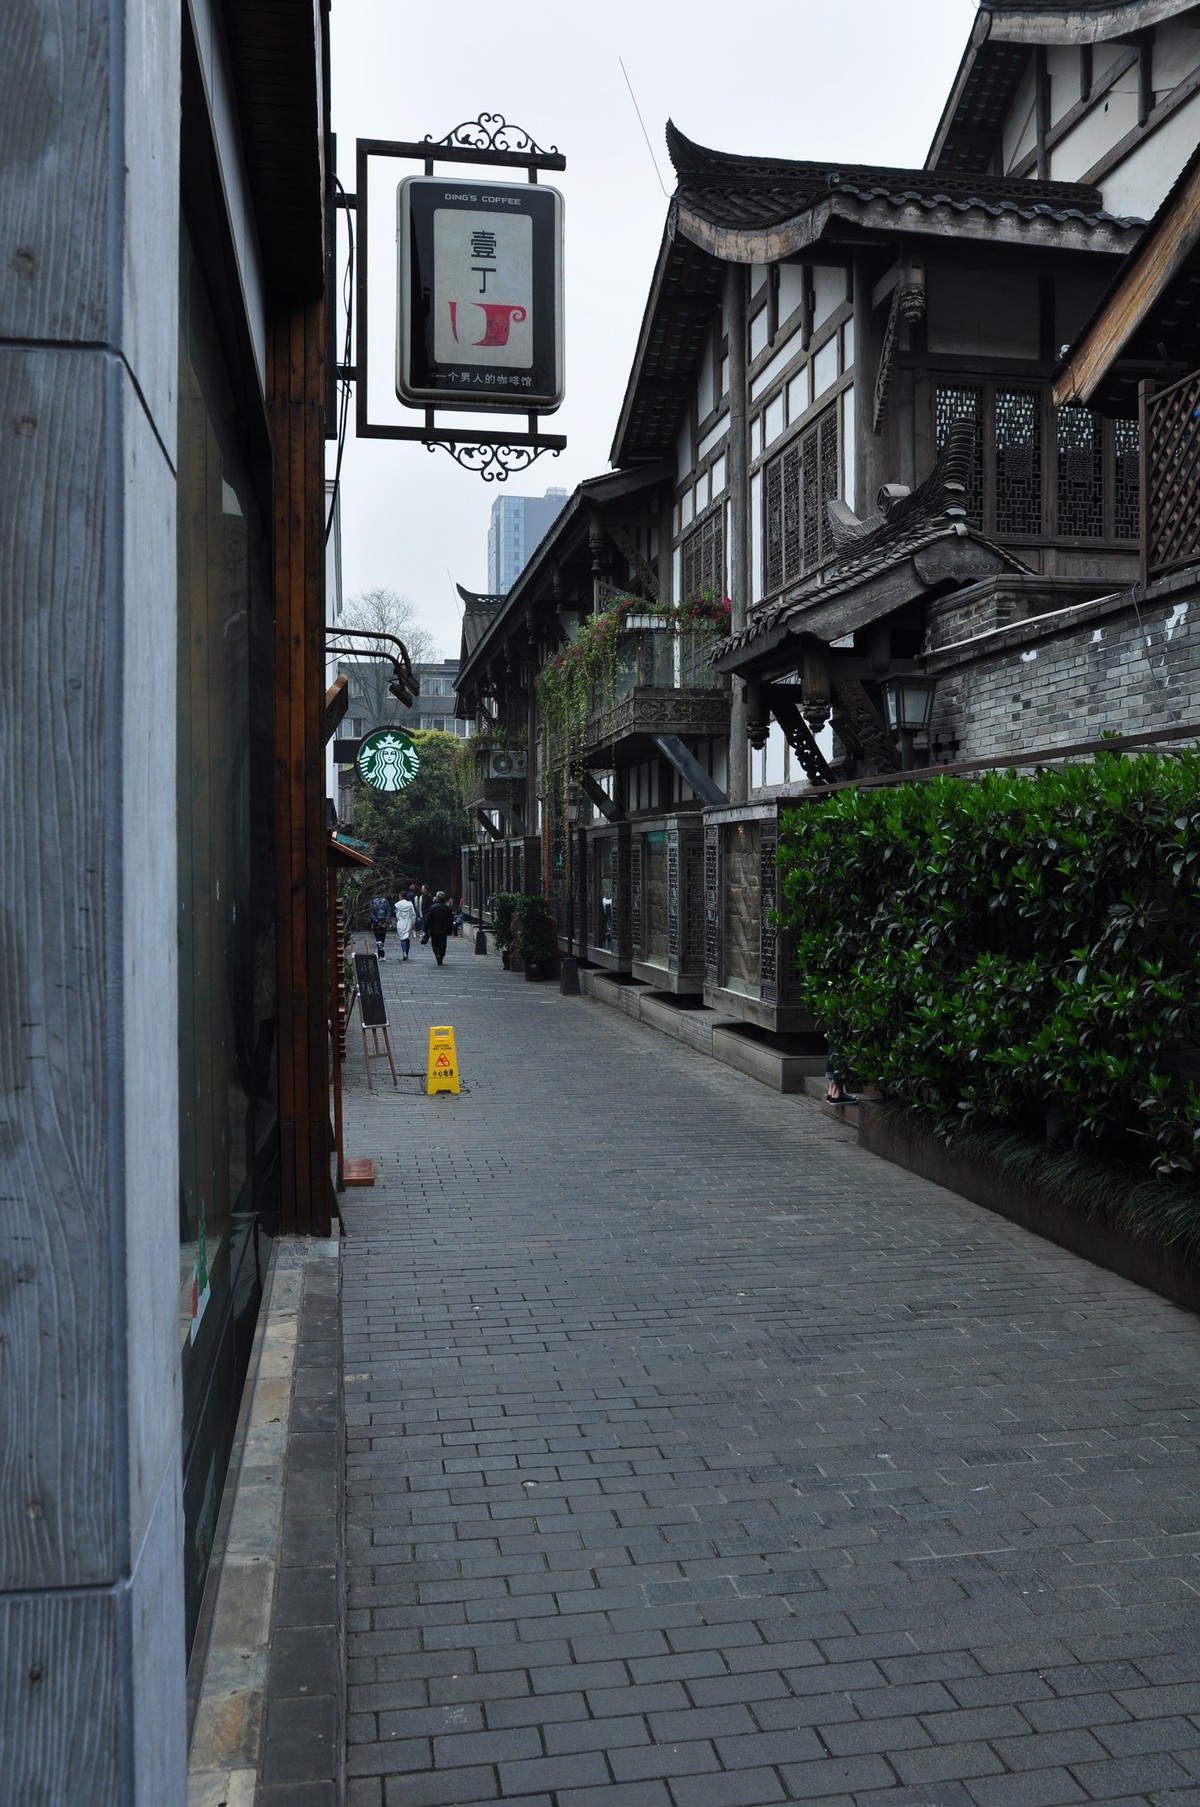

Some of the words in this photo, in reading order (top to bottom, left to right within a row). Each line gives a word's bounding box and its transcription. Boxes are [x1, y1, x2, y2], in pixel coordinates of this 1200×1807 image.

[444, 193, 477, 202] DING'S
[481, 195, 521, 206] COFFEE
[471, 230, 497, 294] 壹丁
[435, 372, 532, 387] 一个男人的咖啡馆
